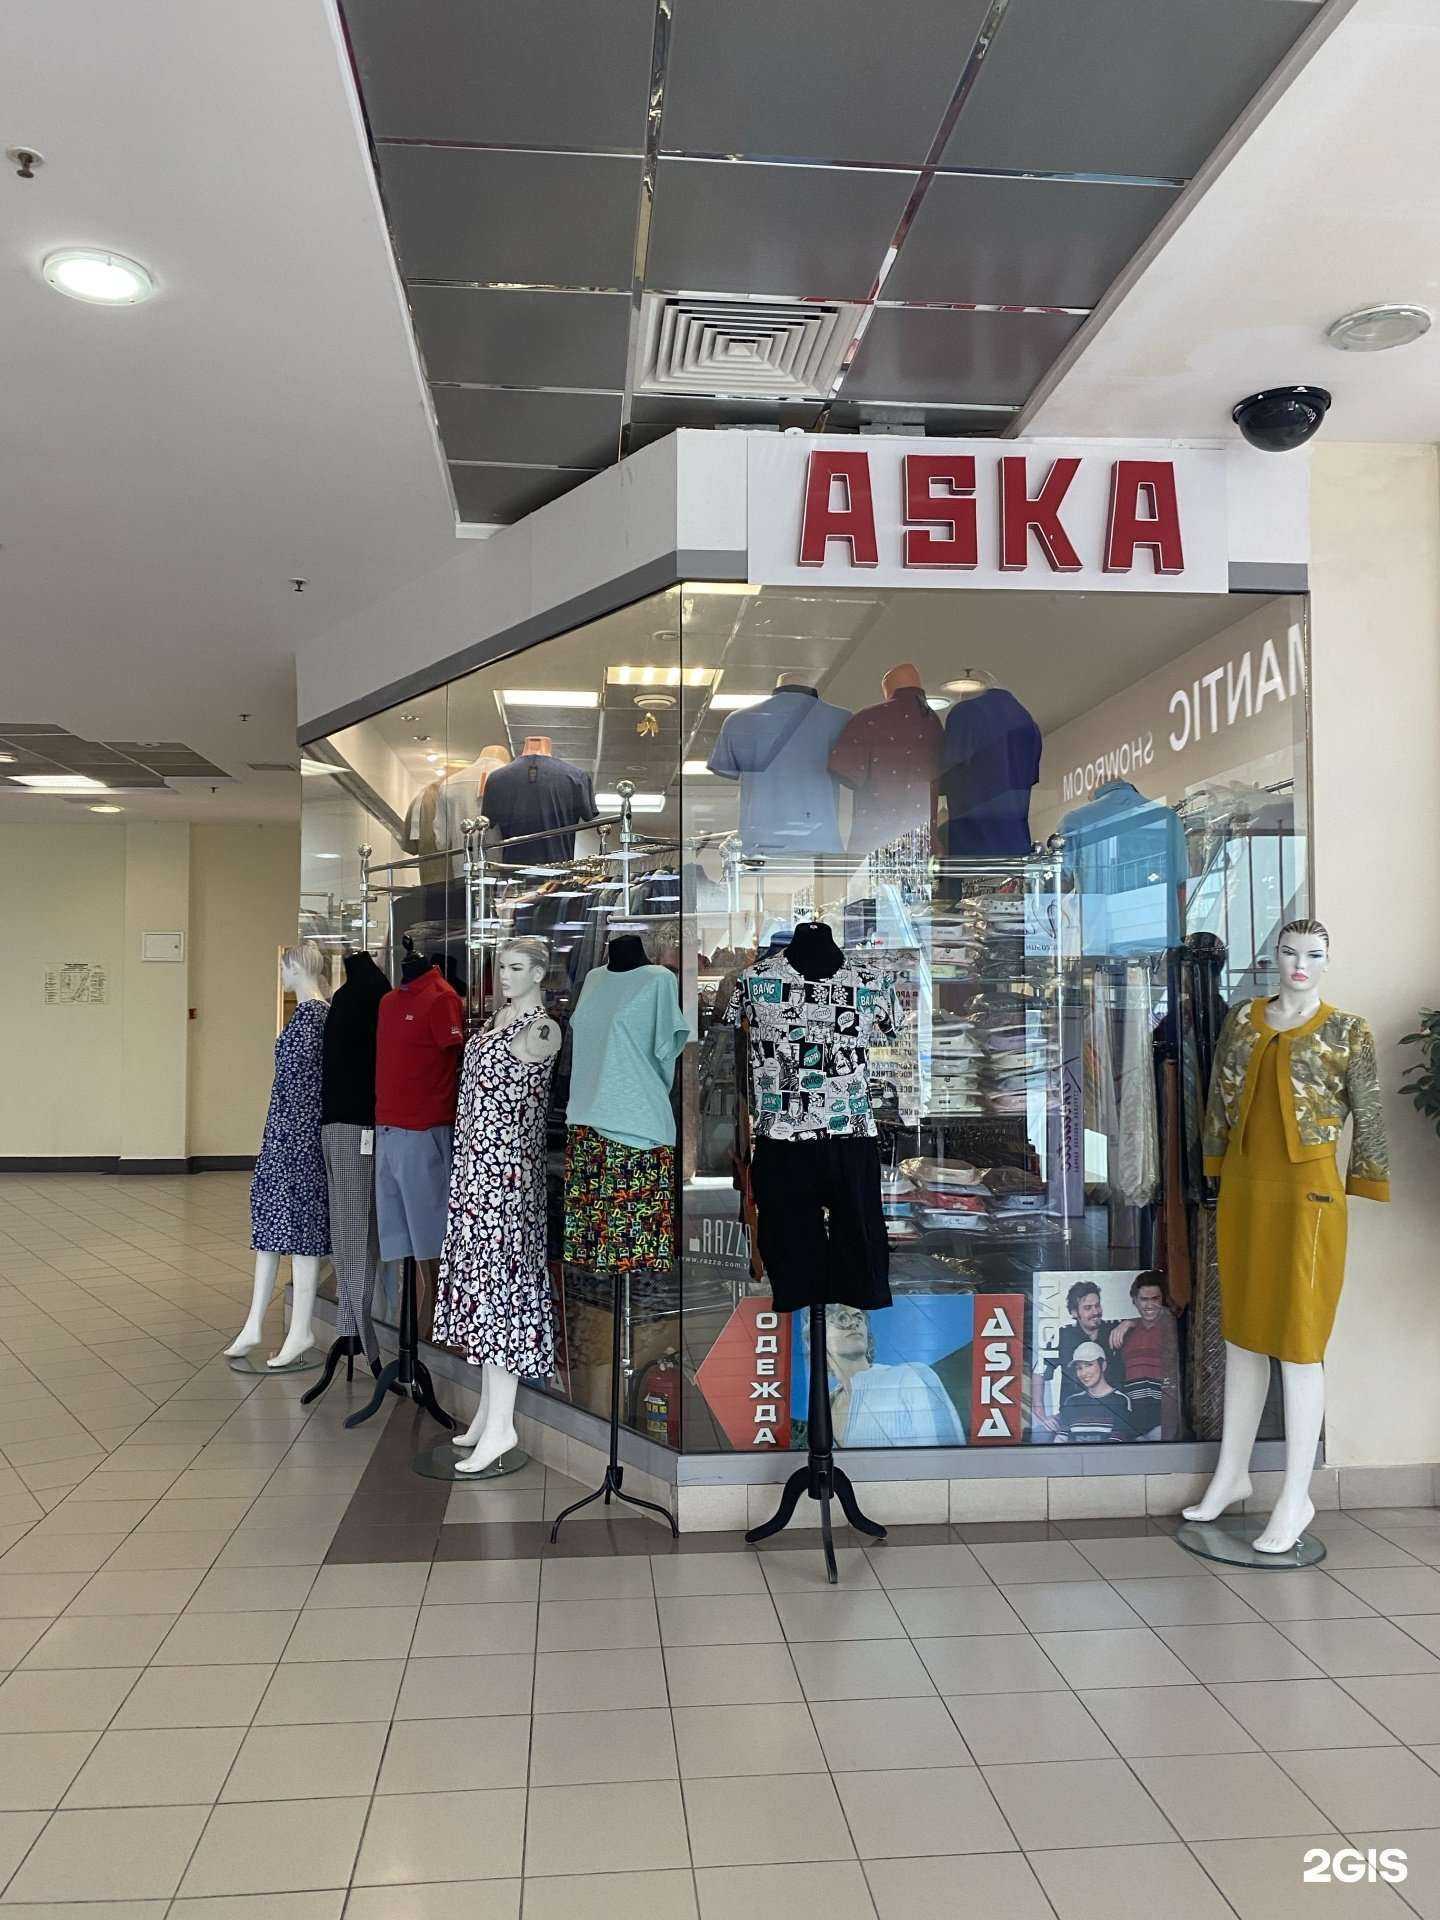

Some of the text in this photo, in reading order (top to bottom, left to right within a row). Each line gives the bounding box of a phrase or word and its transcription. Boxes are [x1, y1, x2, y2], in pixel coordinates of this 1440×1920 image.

[797, 449, 1186, 576] ASKA
[752, 982, 776, 995] BANG
[702, 1218, 753, 1259] RAZZA
[749, 1312, 782, 1444] ОДЕЖДА
[977, 1307, 1015, 1437] ASKA
